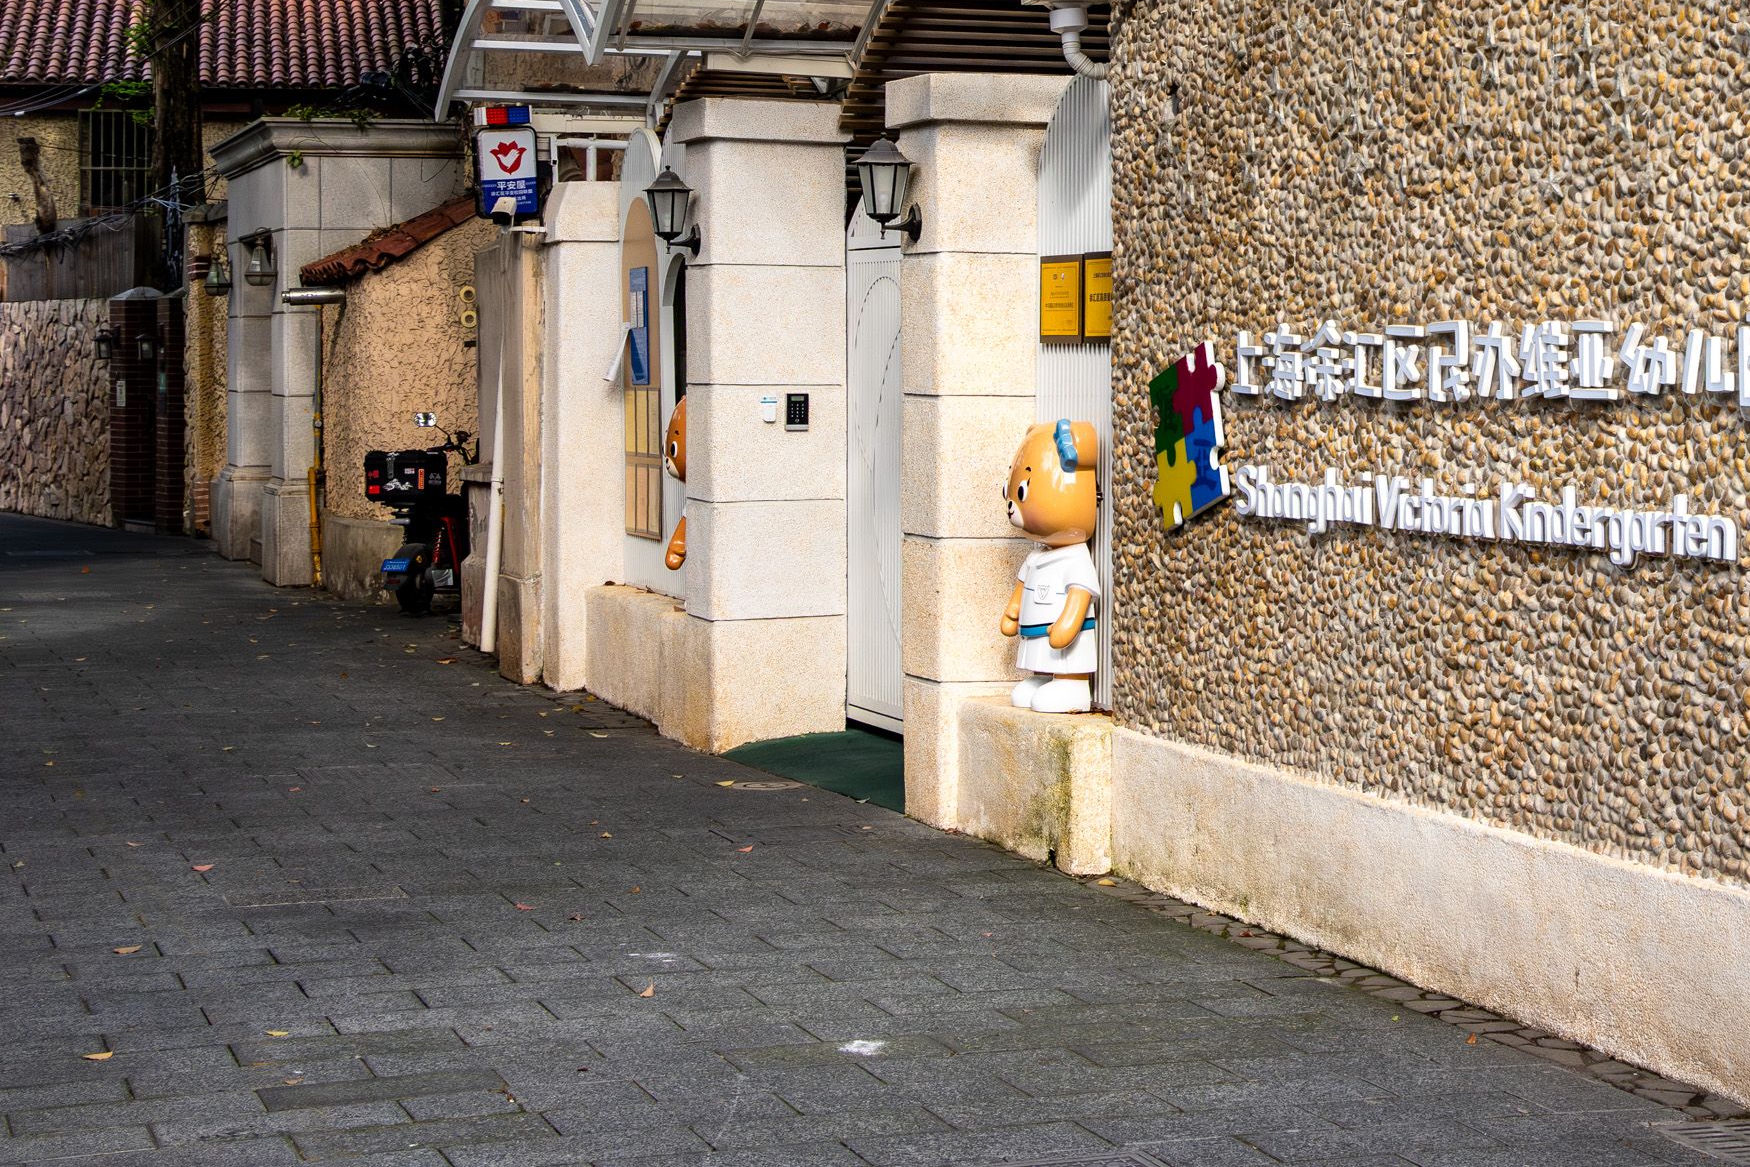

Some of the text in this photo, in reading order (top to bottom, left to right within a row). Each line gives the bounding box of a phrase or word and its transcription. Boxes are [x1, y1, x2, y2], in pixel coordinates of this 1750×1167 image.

[497, 180, 526, 190] 平安屋
[1236, 464, 1373, 533] Shanghai
[1375, 474, 1495, 539] Victoria
[1501, 482, 1738, 566] Kindergarten
